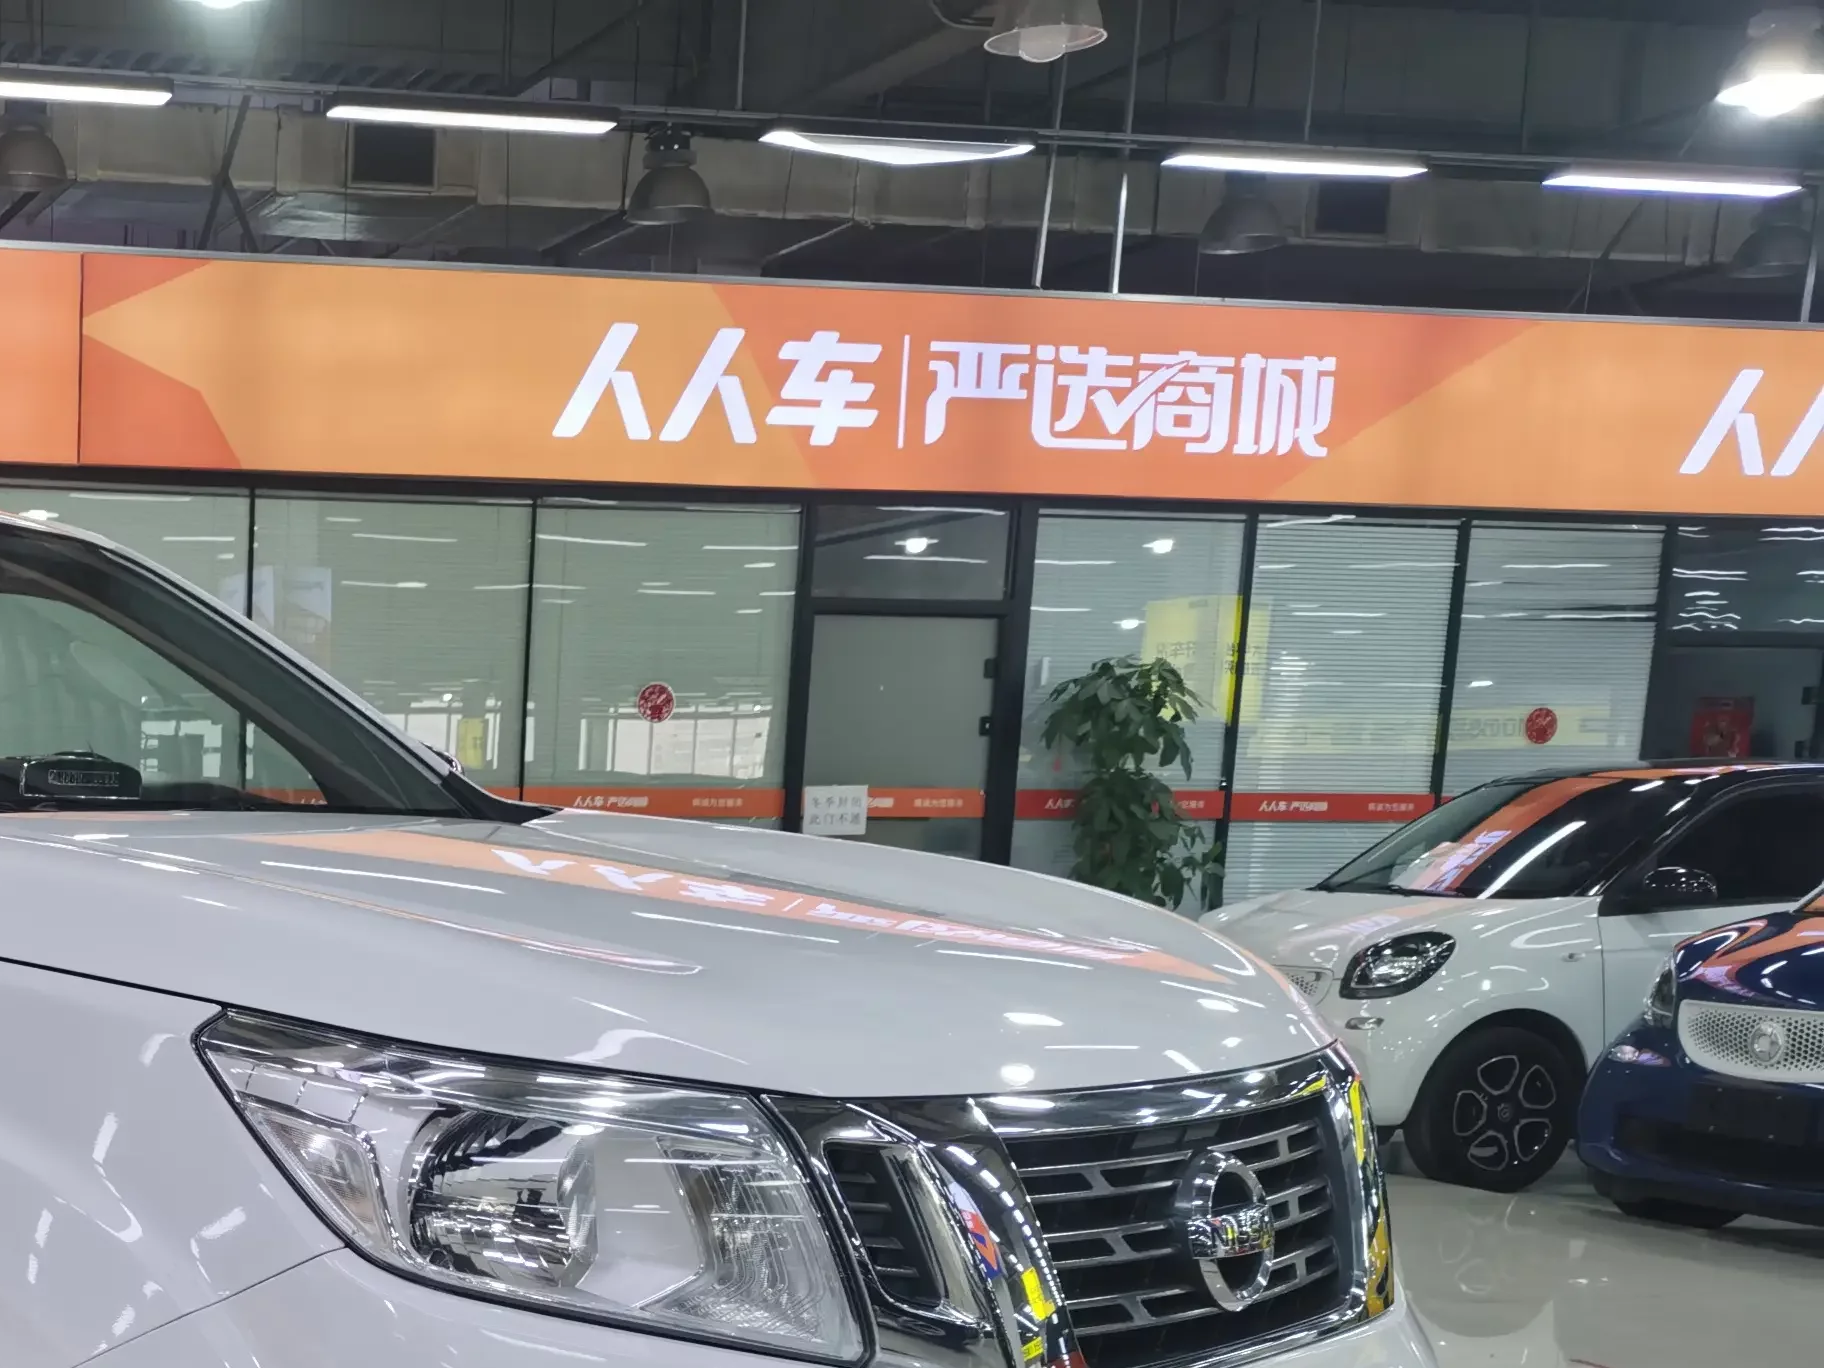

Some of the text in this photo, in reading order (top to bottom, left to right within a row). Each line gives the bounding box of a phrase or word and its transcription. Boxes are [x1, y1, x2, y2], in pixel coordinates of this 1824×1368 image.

[552, 321, 1337, 458] 人人车 严选商城
